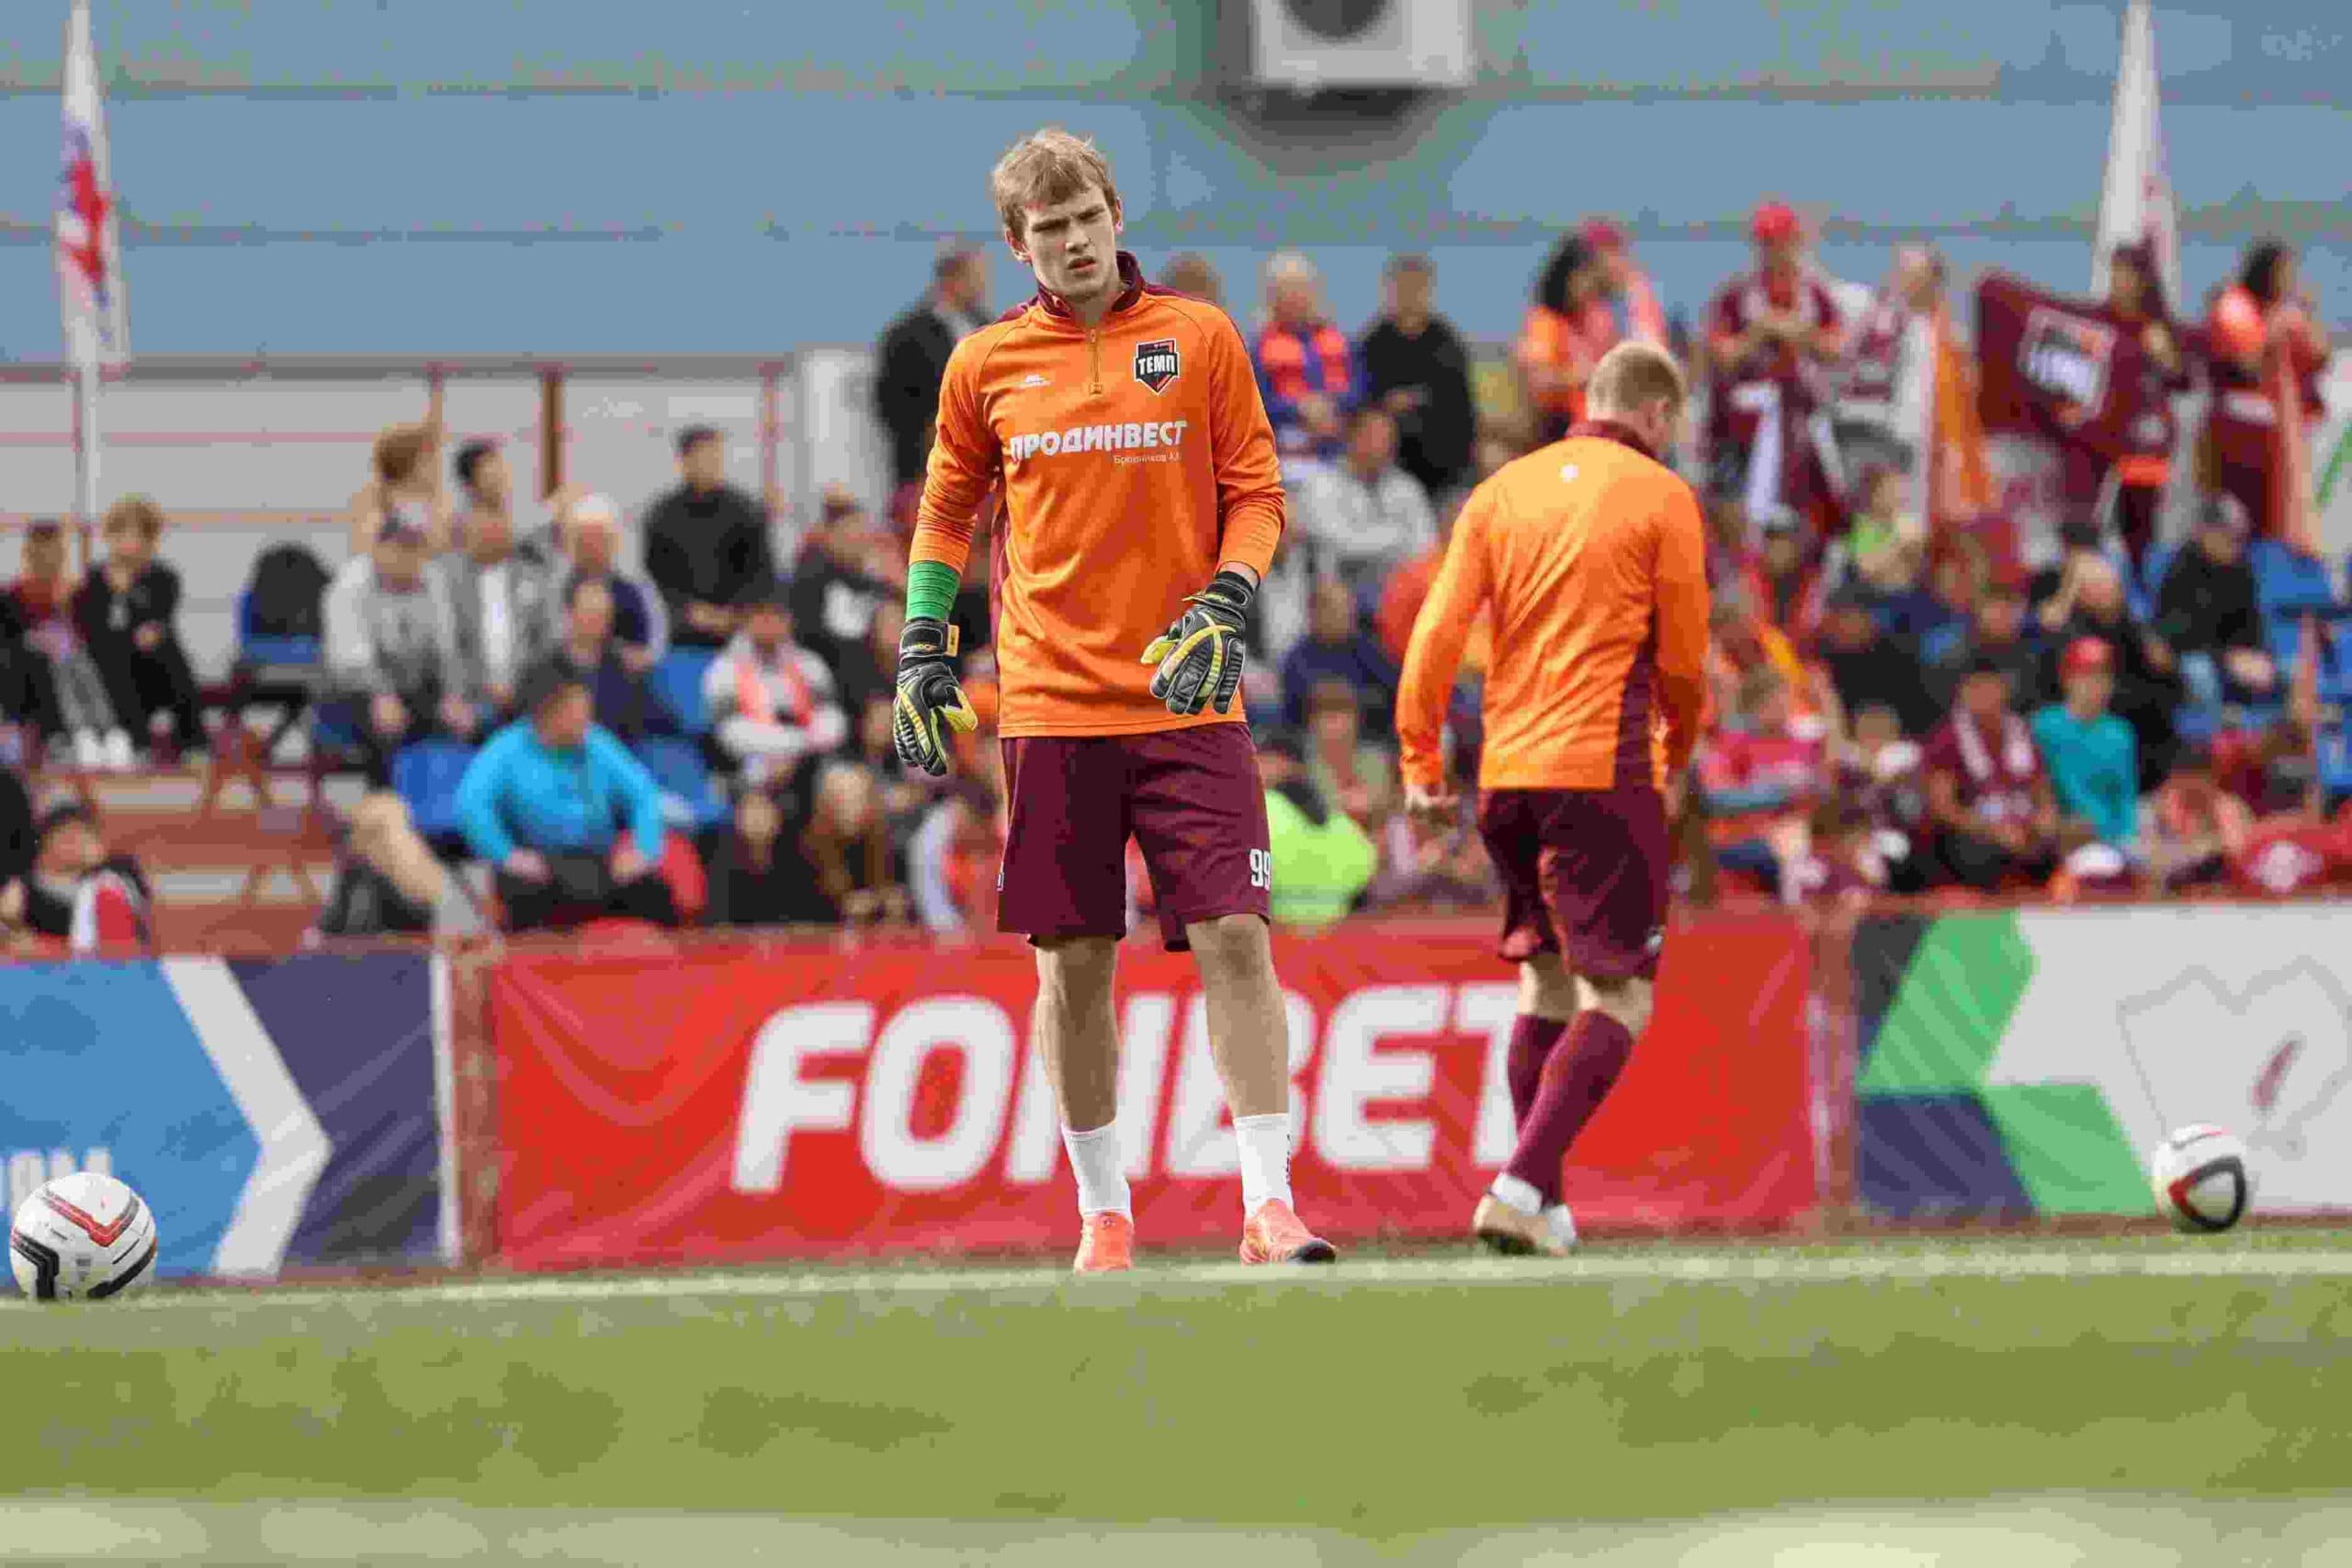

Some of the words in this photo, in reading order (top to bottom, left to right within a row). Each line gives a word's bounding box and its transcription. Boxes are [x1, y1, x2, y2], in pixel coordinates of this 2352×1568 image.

[1137, 354, 1176, 376] ТЕМП
[1010, 420, 1188, 461] ПРОДИНВЕСТ
[729, 978, 1521, 1196] FONBET
